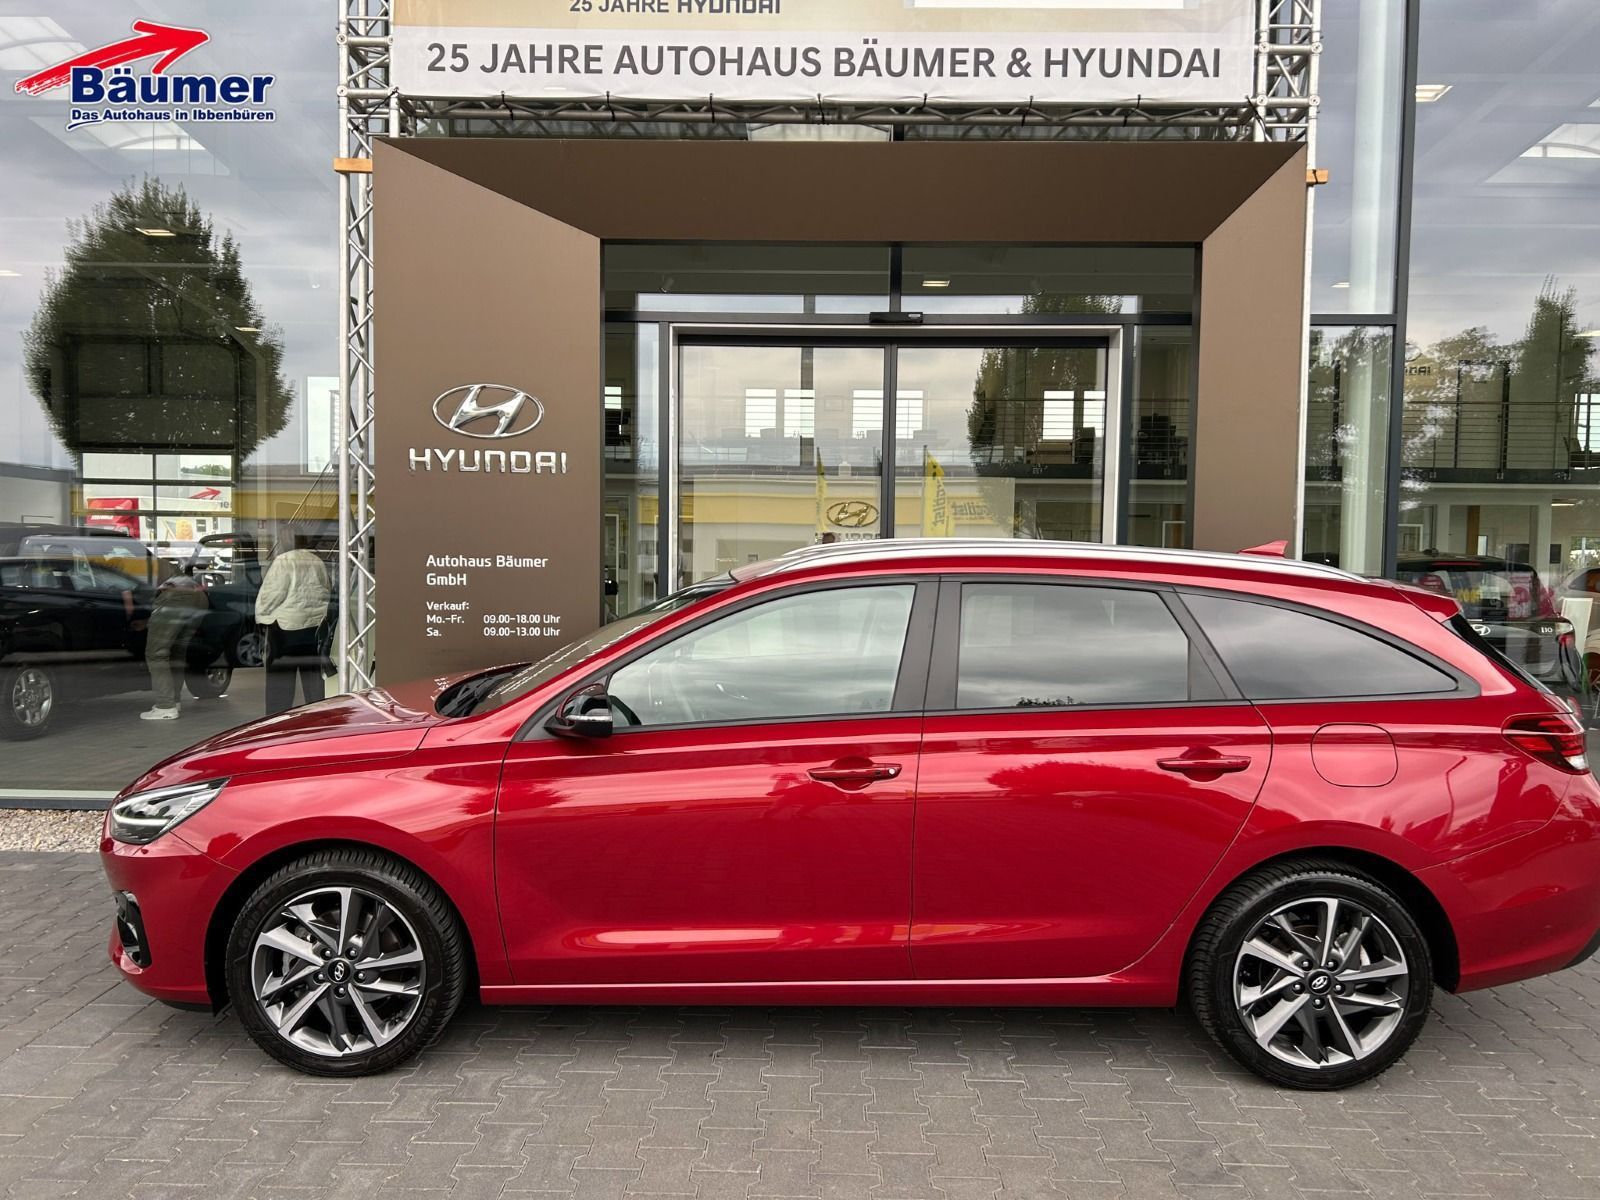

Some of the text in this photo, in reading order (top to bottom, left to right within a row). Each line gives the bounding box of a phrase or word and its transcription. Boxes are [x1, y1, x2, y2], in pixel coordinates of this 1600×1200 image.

[569, 0, 781, 14] 25 JAHRE HYUNDAI
[427, 38, 1221, 78] 25 JAHRE AUTOHAUS BÄUMER & HYUNDAI
[409, 447, 567, 474] HYUNDAI
[425, 554, 549, 568] Autohaus Bäumer
[426, 572, 467, 586] GmbH
[426, 601, 470, 611] Verkauf:
[426, 614, 561, 624] Mo.-Fr. 09.00-18.00 Uhr
[426, 627, 561, 637] Sa. 09.00-13.00 Uhr
